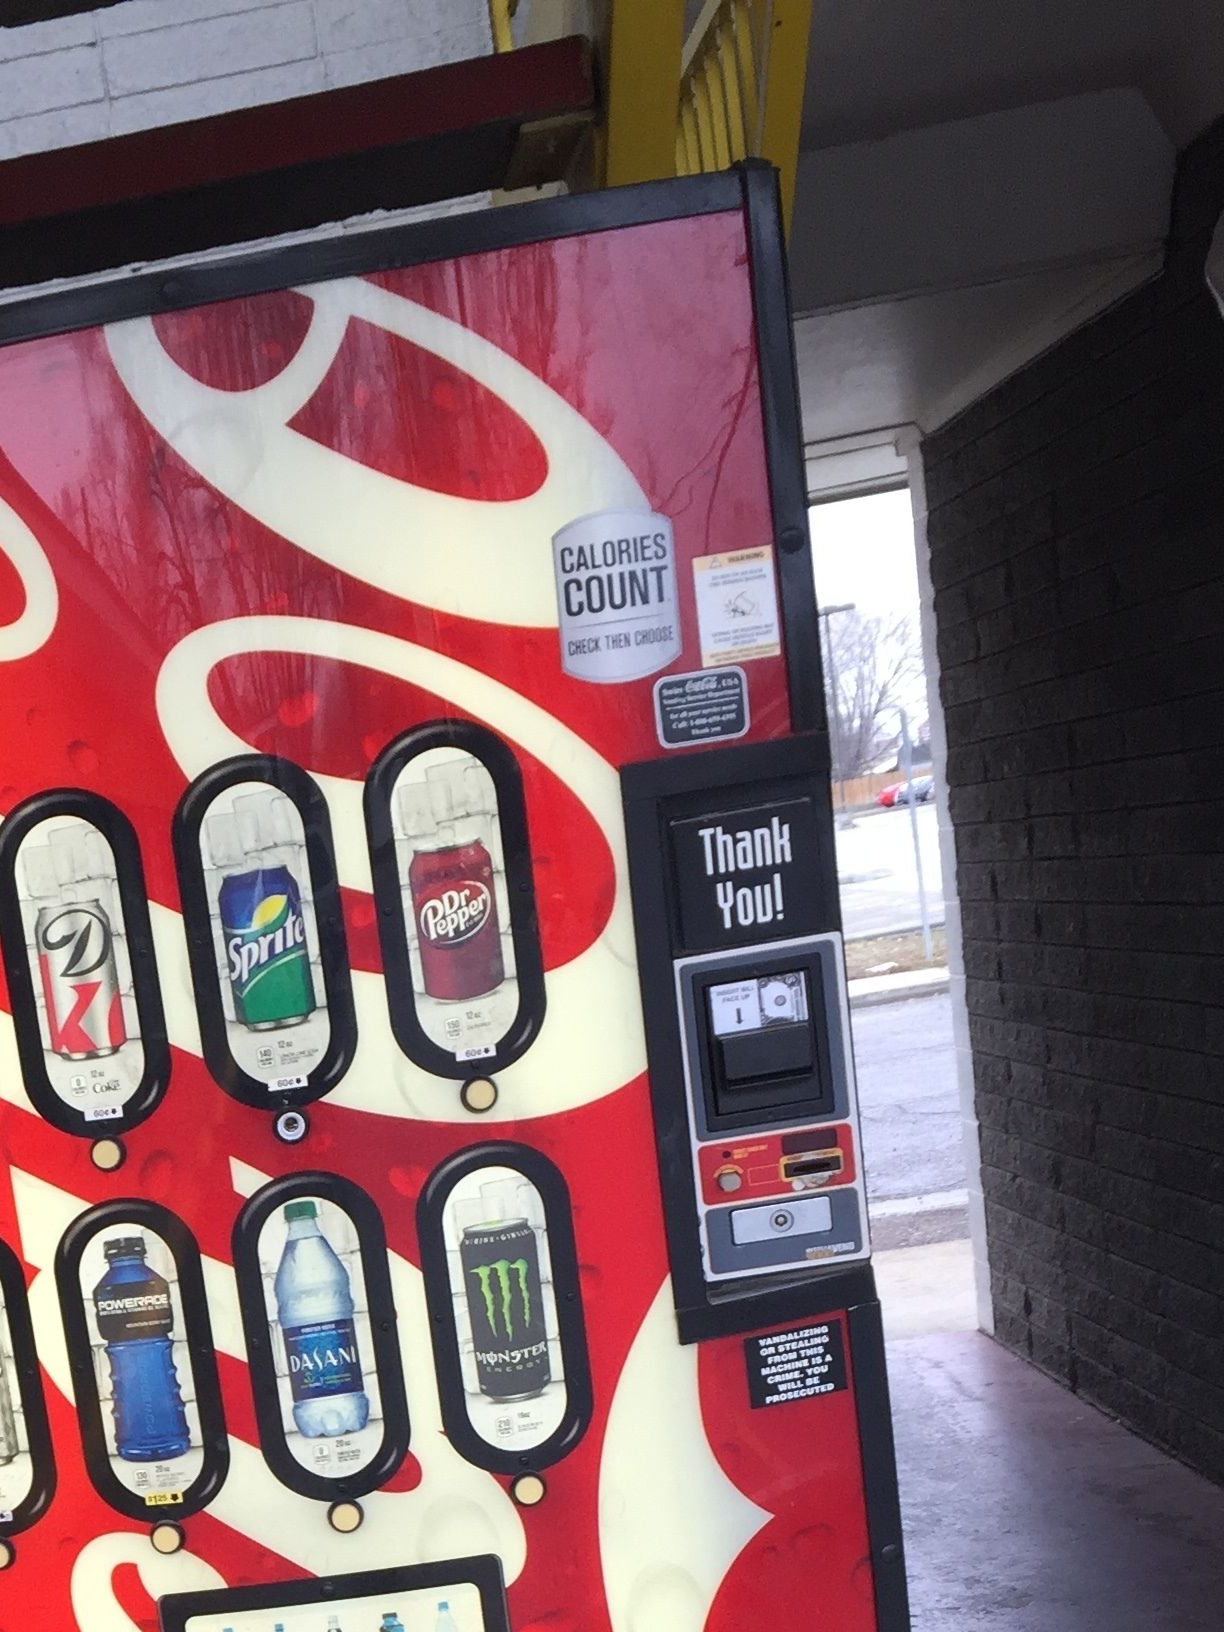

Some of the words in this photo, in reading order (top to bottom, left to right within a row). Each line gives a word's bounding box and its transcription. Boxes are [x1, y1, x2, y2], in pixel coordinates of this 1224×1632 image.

[560, 533, 667, 574] CALORIES
[563, 565, 668, 617] COUNT
[568, 636, 602, 656] CHECK
[605, 632, 631, 650] THEN
[634, 625, 674, 646] CHOOSE
[698, 816, 792, 876] Thank
[442, 888, 471, 916] Dr
[716, 873, 784, 929] You!
[420, 893, 487, 940] Pepper
[228, 908, 305, 983] Sprite
[97, 1294, 168, 1311] POWERADE
[758, 1325, 829, 1347] VANDALIZING
[760, 1346, 776, 1356] OR
[777, 1335, 830, 1352] STEALING
[289, 1345, 357, 1373] DASANI
[475, 1341, 547, 1366] MONSTER
[761, 1359, 810, 1376] MACHINE
[811, 1356, 823, 1365] IS
[824, 1354, 833, 1362] A
[767, 1352, 797, 1364] FROM
[799, 1346, 825, 1357] THIS
[767, 1370, 804, 1384] CRIME.
[806, 1365, 829, 1376] YOU
[777, 1381, 804, 1391] WILL
[805, 1376, 820, 1386] BE
[765, 1383, 835, 1404] PROSECUTED
